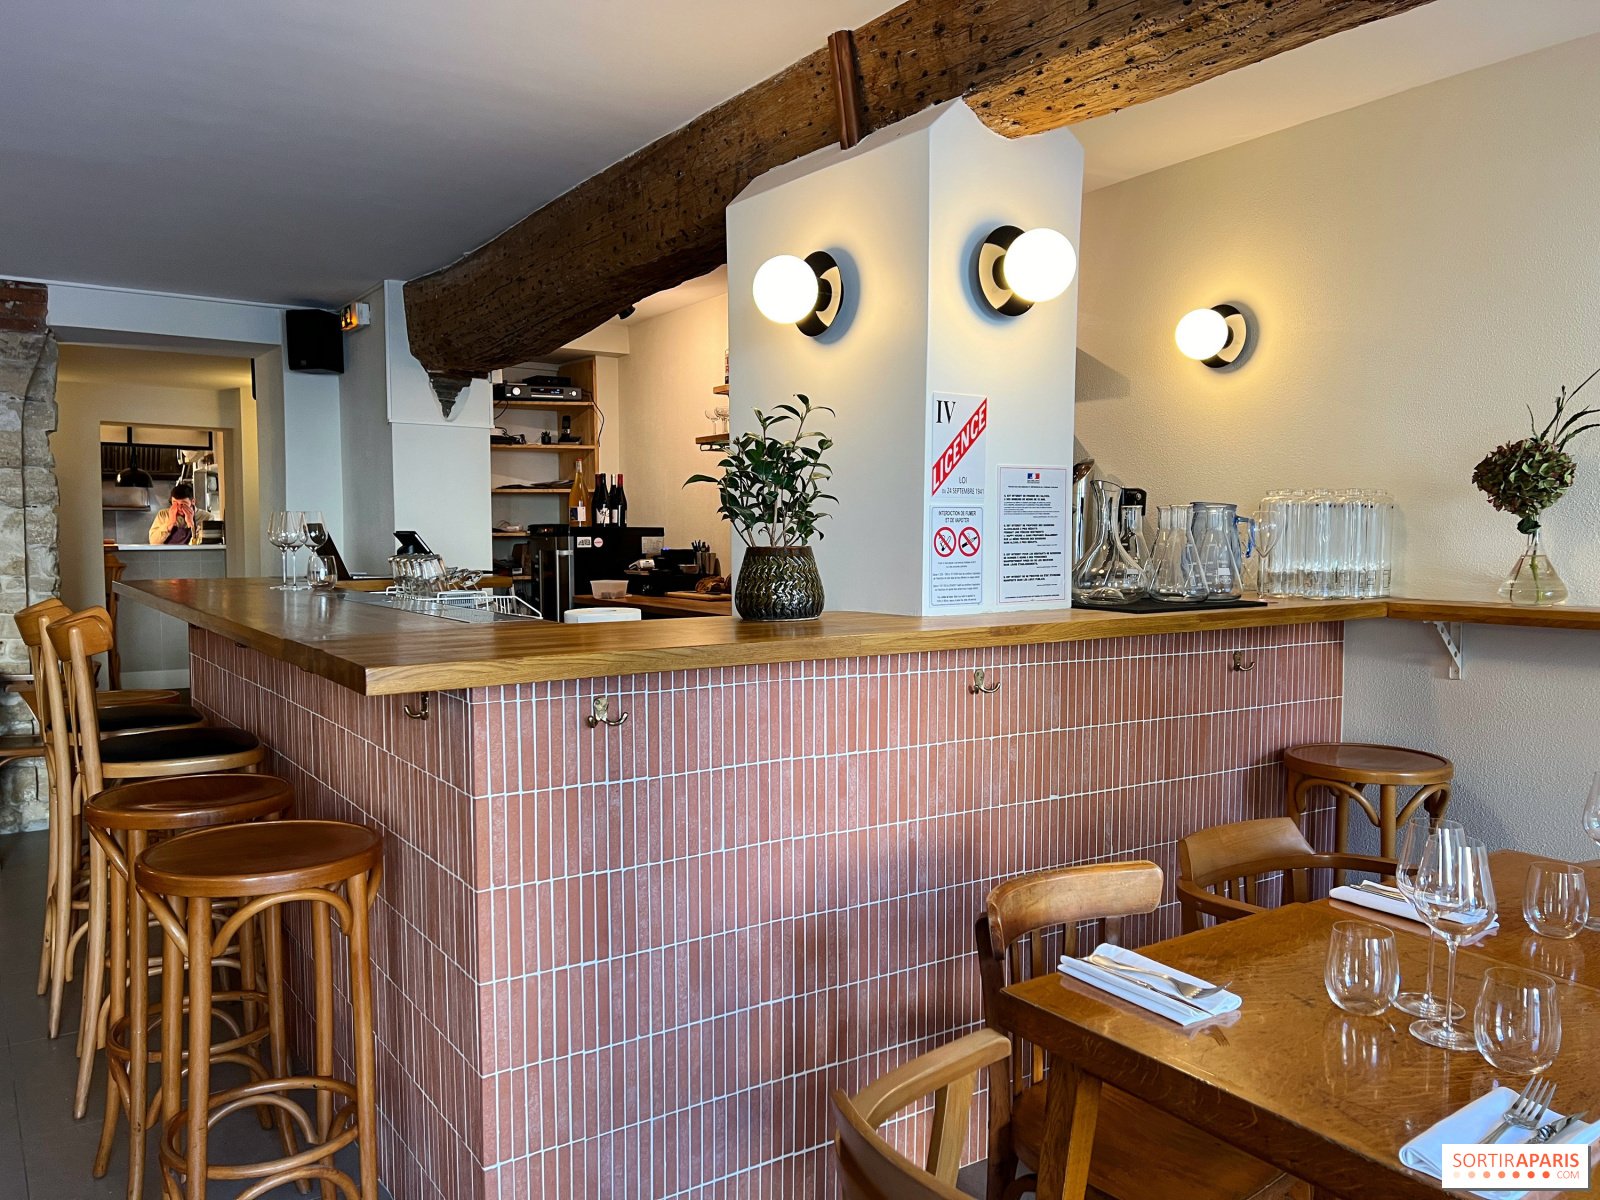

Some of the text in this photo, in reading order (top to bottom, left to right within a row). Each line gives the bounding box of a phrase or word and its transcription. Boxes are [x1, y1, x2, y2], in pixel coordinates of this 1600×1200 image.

[936, 400, 956, 424] IV
[932, 402, 987, 492] LICENCE
[959, 476, 968, 484] LOI
[952, 487, 975, 495] SEPTEMBRE
